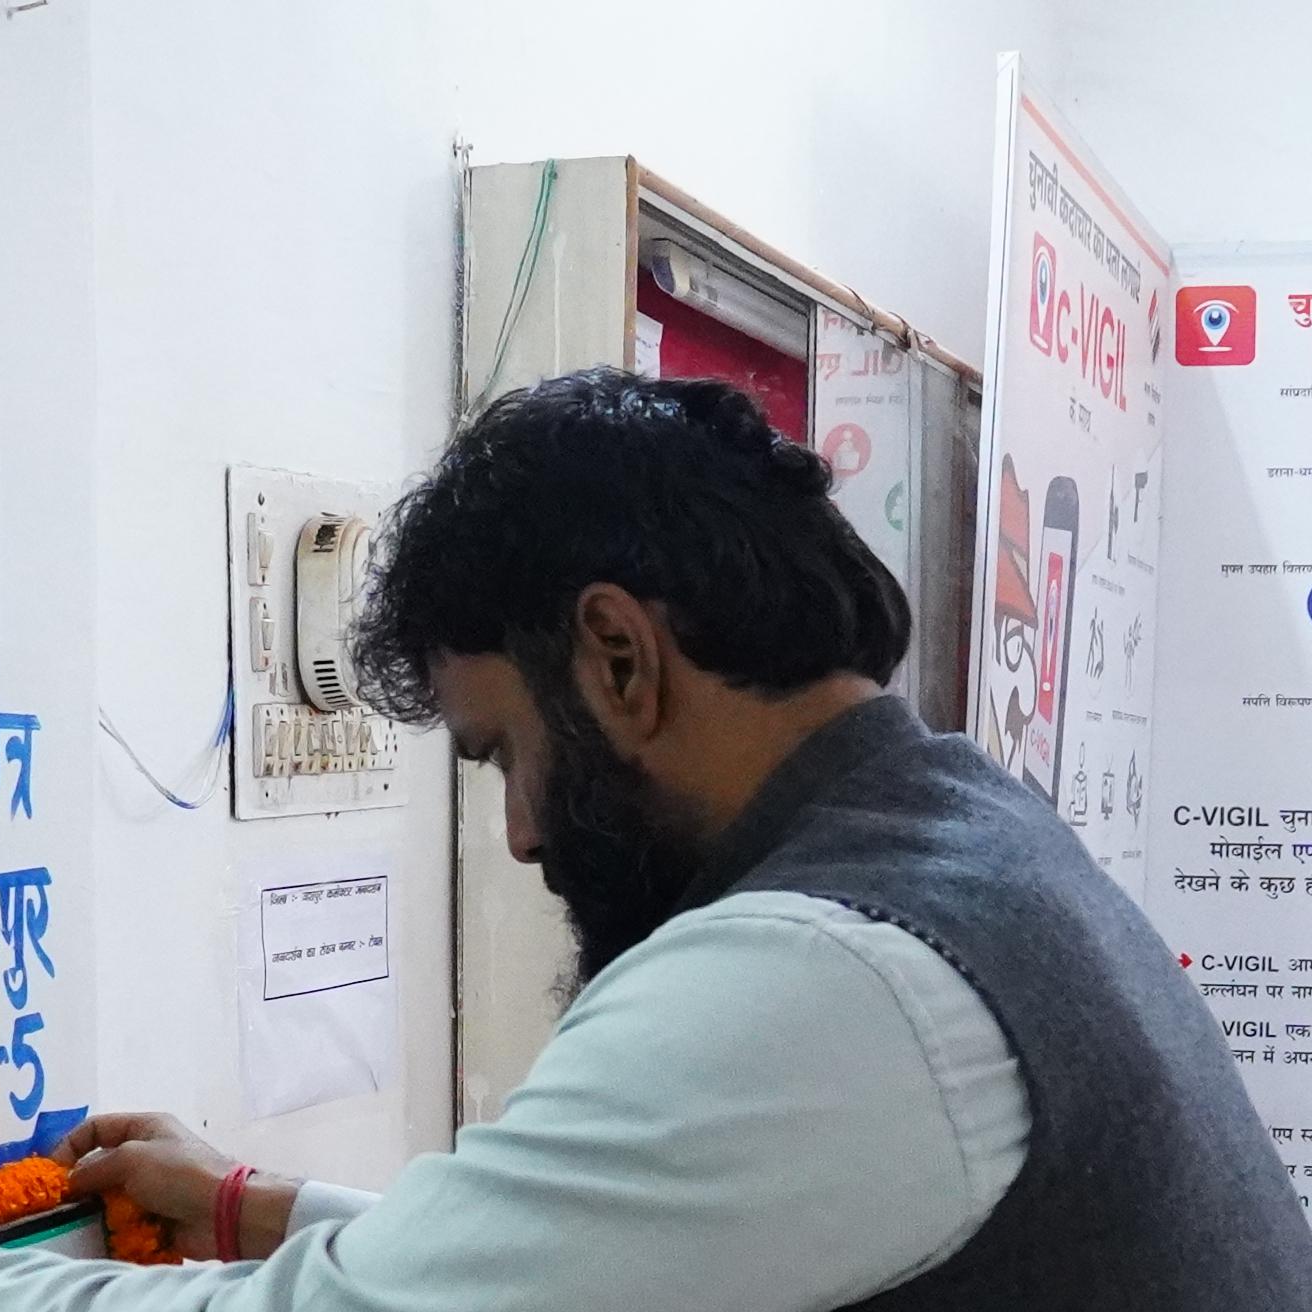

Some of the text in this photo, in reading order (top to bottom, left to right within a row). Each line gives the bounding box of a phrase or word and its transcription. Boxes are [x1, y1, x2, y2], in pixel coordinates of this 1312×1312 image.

[1056, 280, 1126, 413] C-VIGIL
[1249, 564, 1277, 574] उपहार
[1174, 805, 1268, 827] C-VIGIL
[1211, 840, 1282, 862] मोबाईल
[1174, 870, 1221, 892] देखने
[1230, 873, 1249, 892] के
[1260, 877, 1294, 899] कुछ
[1201, 955, 1279, 973] C-VIGIL
[1200, 978, 1257, 998] उल्लंघन
[1266, 984, 1284, 999] पर
[1286, 1024, 1310, 1040] एक
[1263, 1045, 1275, 1063] में
